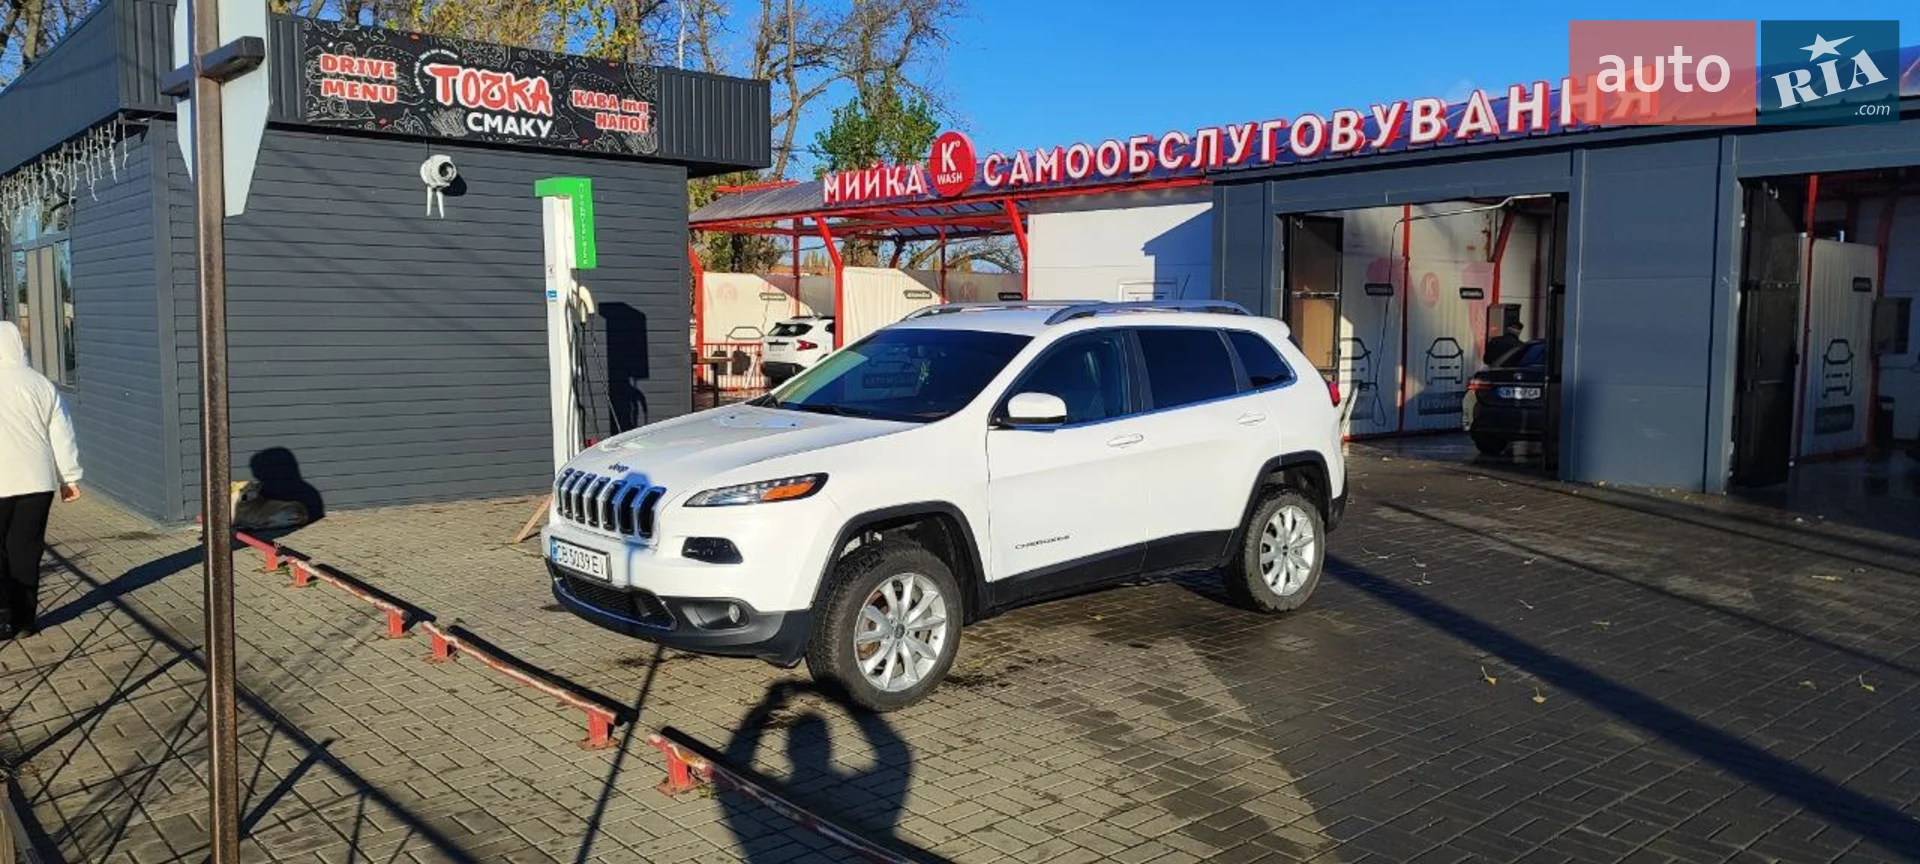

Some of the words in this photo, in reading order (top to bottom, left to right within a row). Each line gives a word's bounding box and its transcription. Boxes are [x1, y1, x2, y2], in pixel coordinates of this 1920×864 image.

[321, 53, 395, 78] DRIVE
[321, 78, 397, 103] MENU
[573, 90, 619, 111] КАВА
[467, 112, 552, 138] СМАКУ
[595, 113, 648, 132] НАПОЇ
[824, 161, 928, 204] МИЙКА
[983, 65, 1658, 188] САМООБСЛУГОВУВАННЯ
[937, 171, 963, 185] WASH
